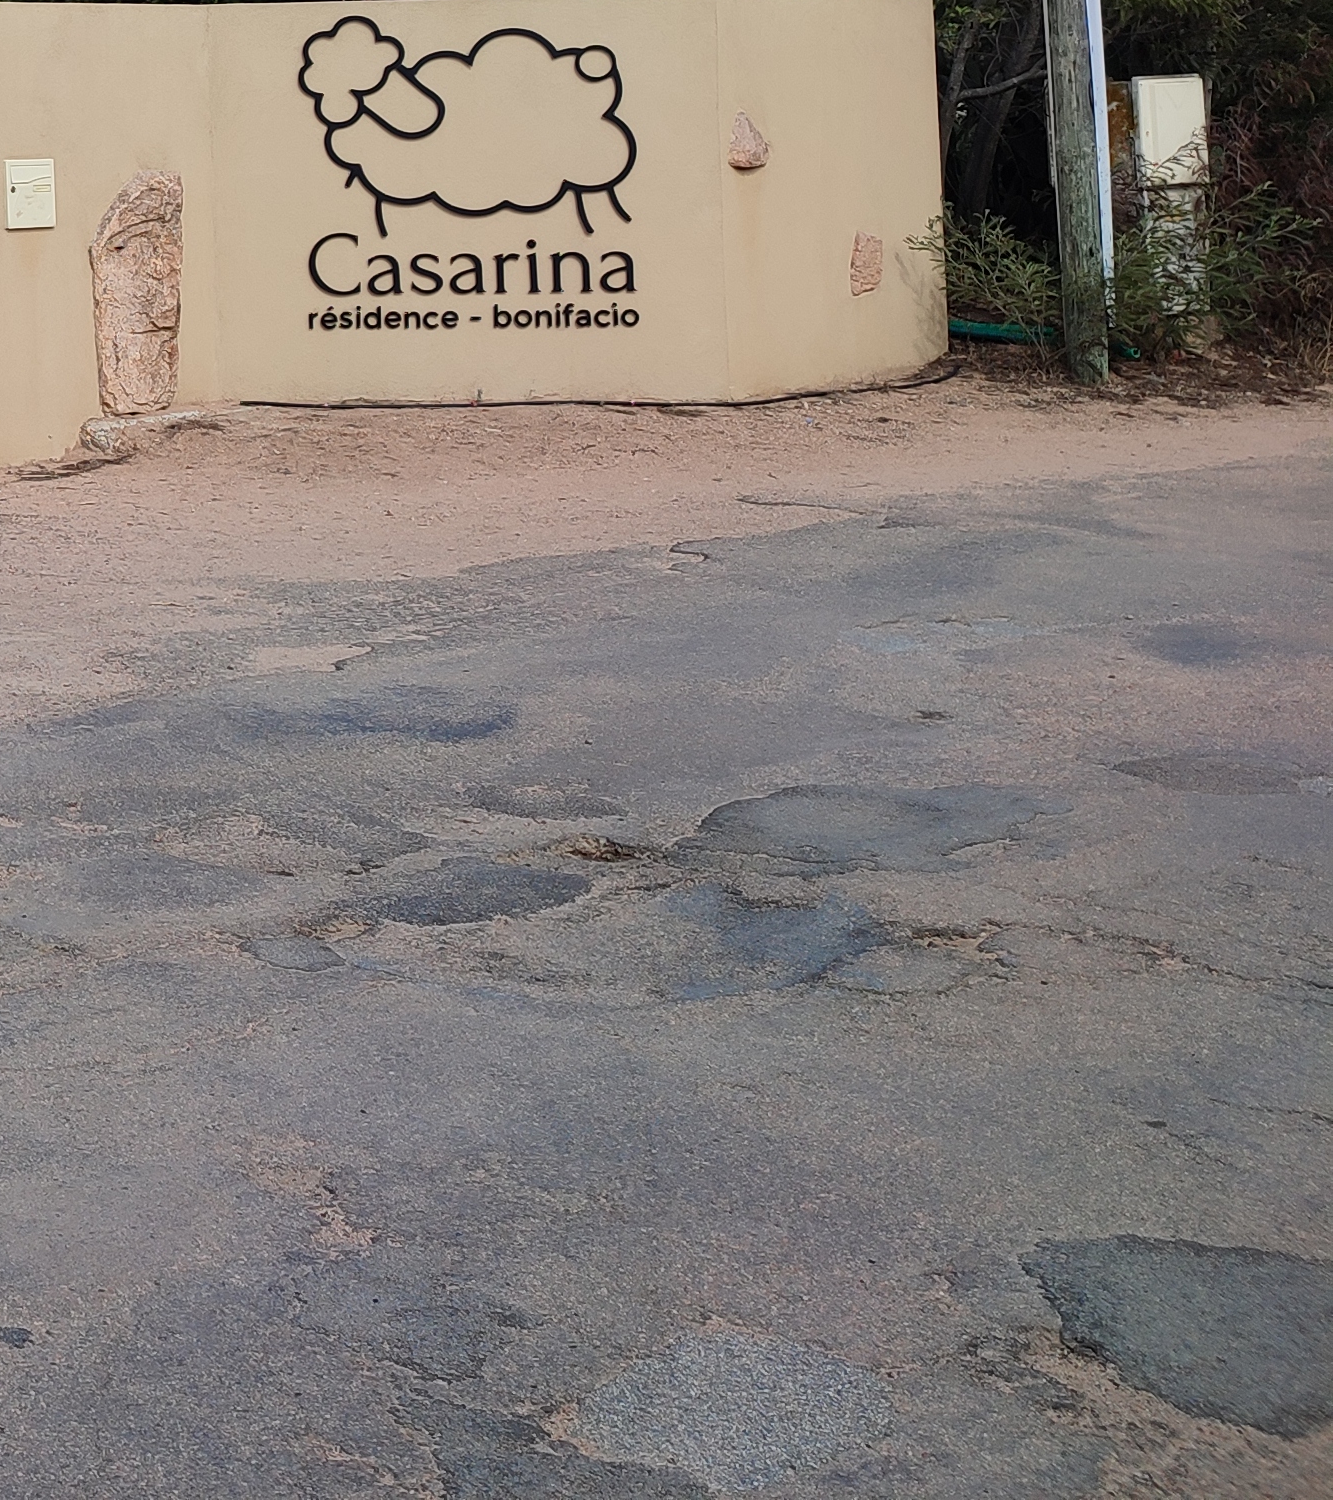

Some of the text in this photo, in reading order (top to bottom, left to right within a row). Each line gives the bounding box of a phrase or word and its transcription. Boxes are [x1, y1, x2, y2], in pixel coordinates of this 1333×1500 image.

[308, 232, 637, 296] Casarina
[308, 305, 460, 331] résidence
[492, 302, 640, 330] bonifacio
